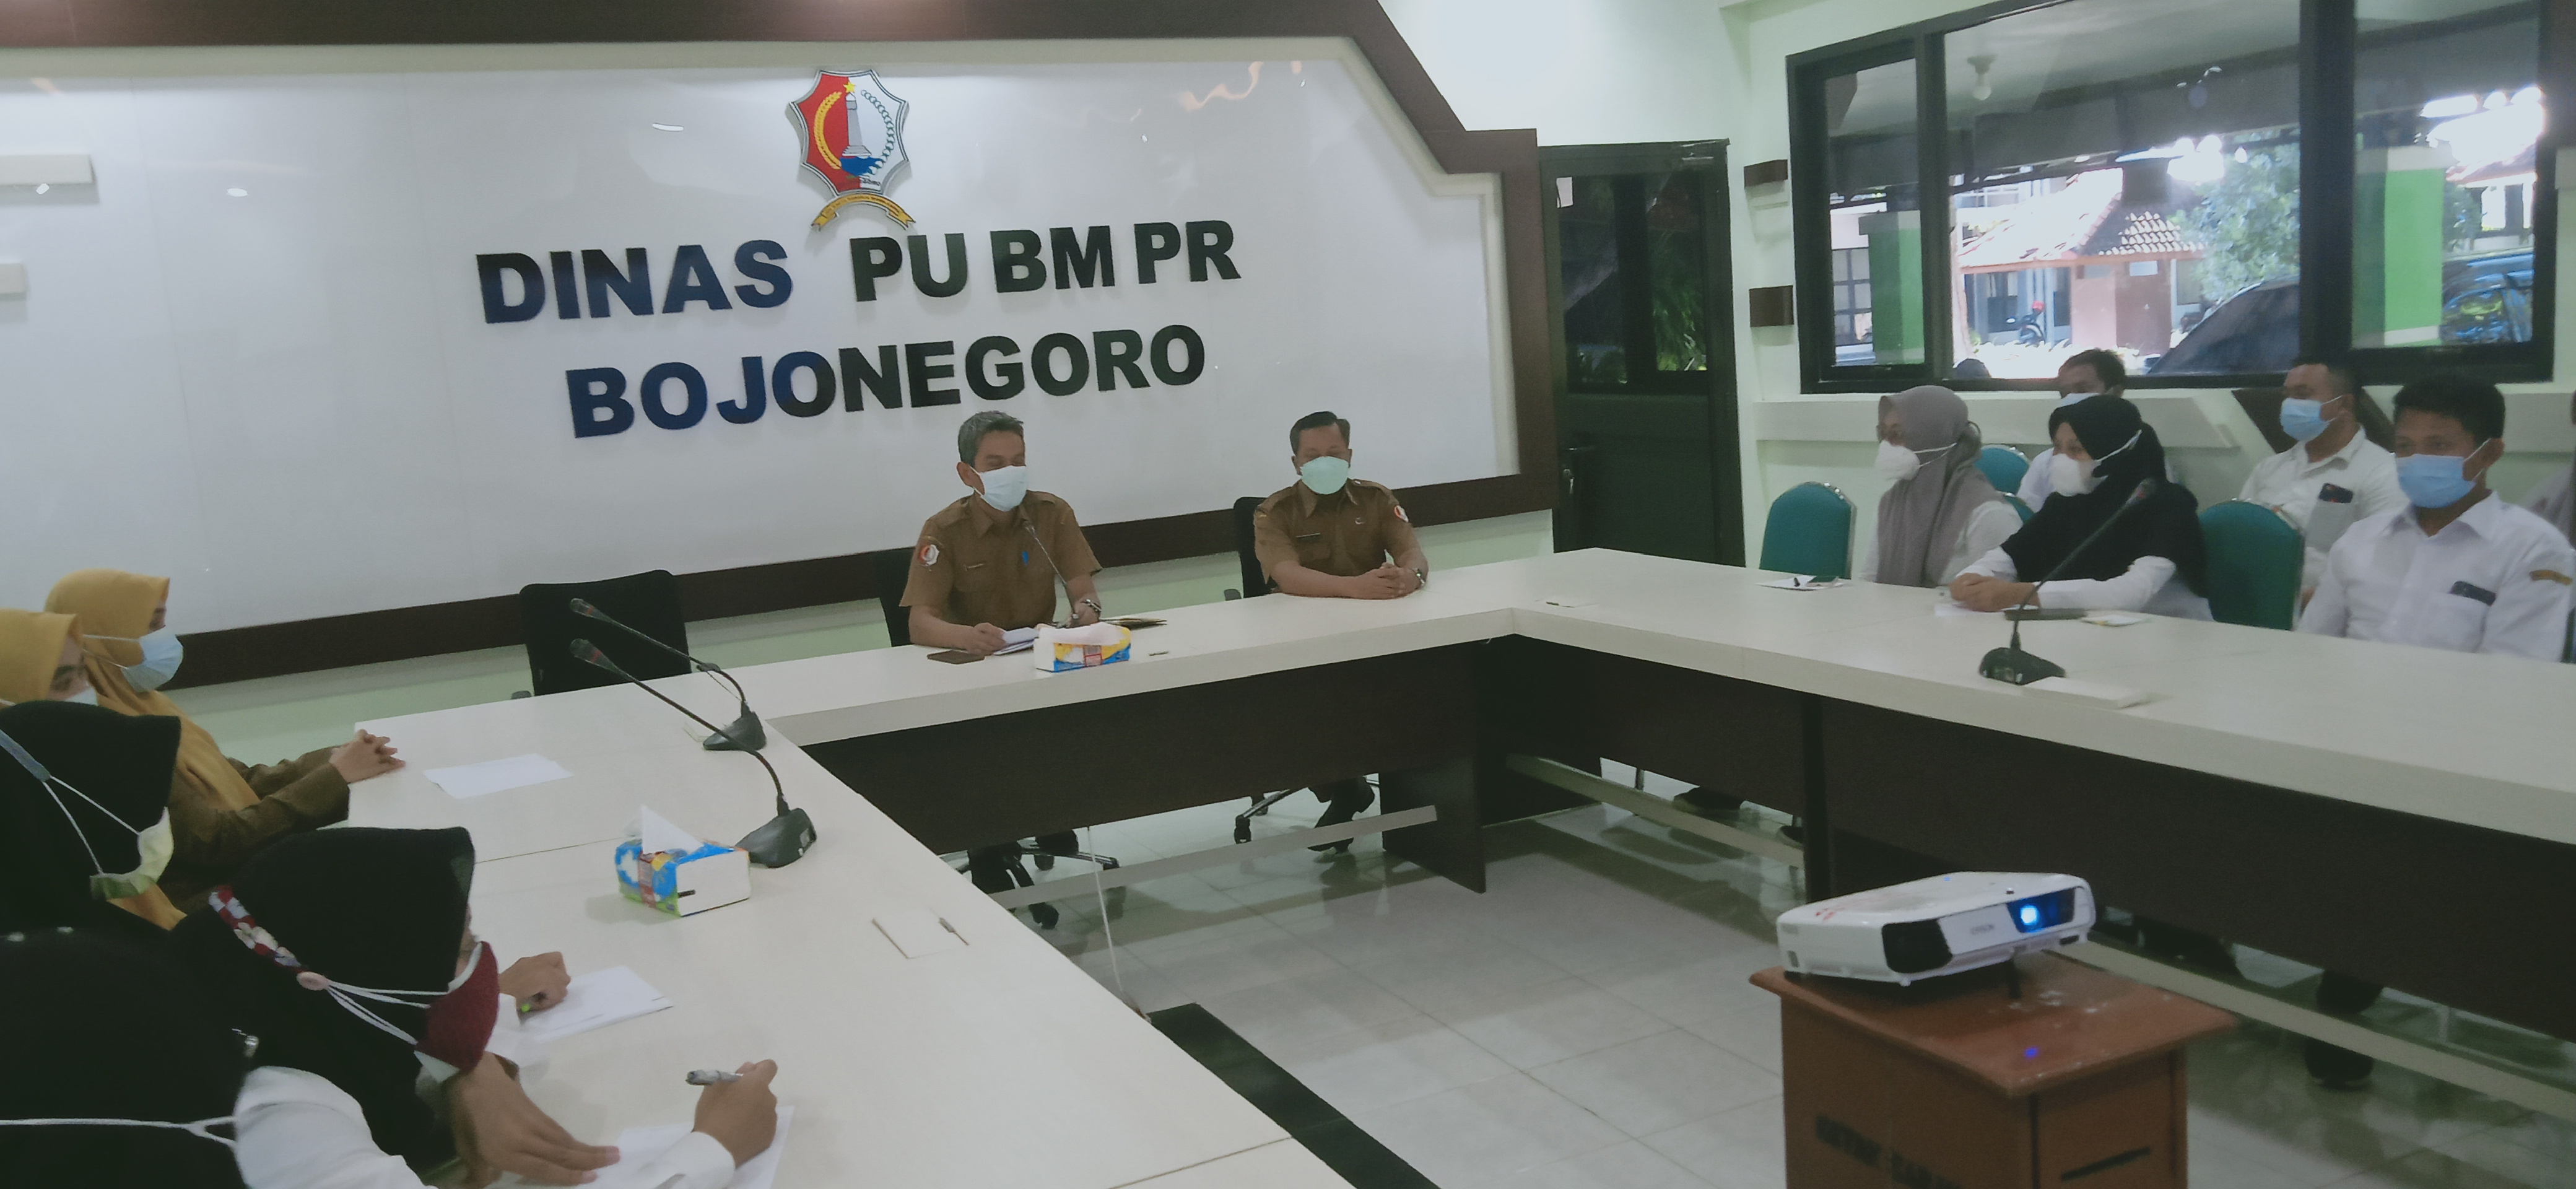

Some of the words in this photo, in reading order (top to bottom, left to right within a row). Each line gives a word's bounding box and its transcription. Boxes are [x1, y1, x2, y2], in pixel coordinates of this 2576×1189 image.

[476, 239, 793, 324] DINAS
[849, 233, 968, 302] PU
[990, 225, 1116, 294] BM
[1133, 220, 1242, 284] PR
[565, 324, 1206, 440] BOJONEGORO
